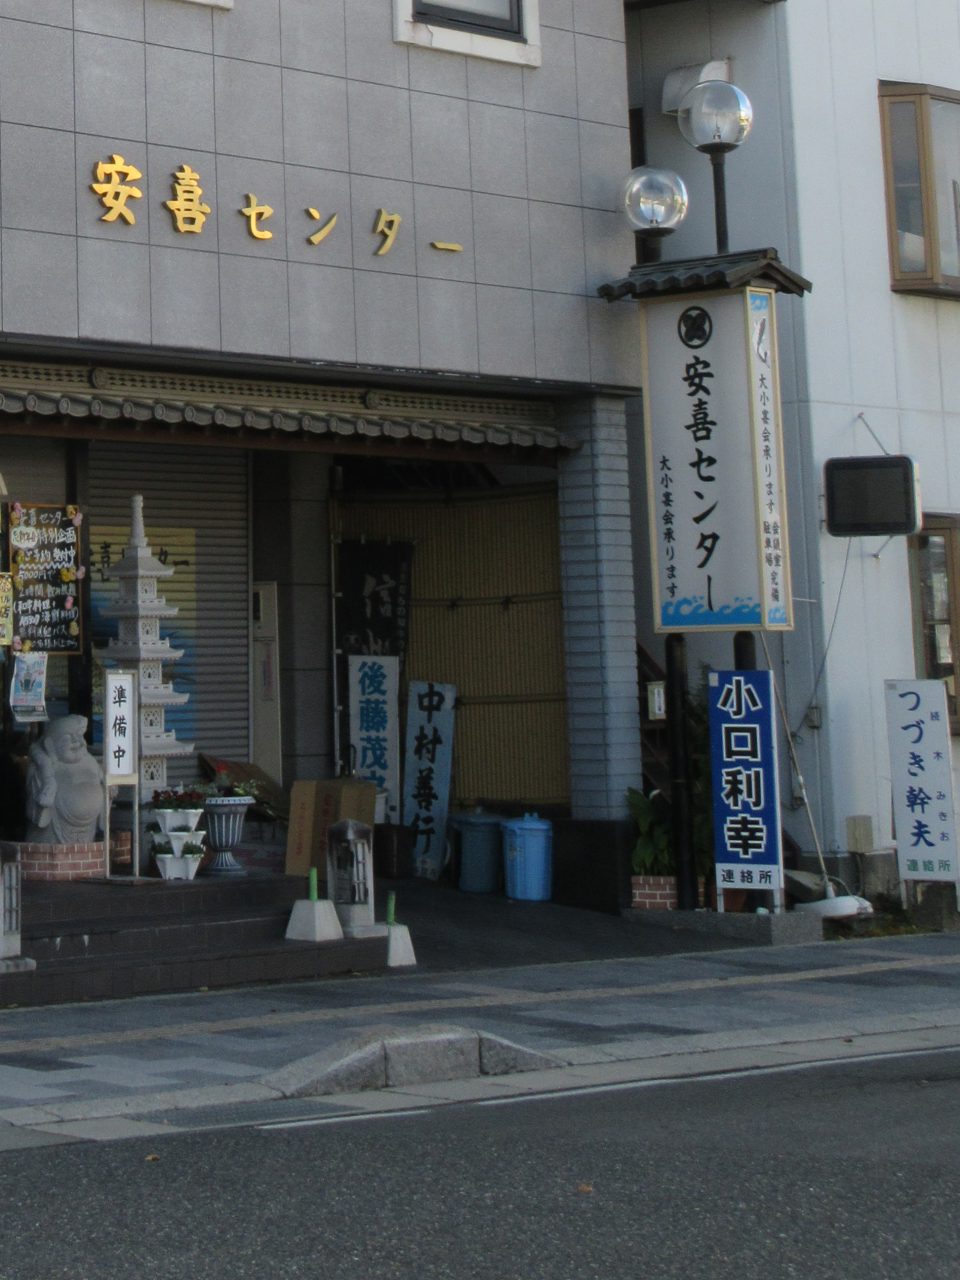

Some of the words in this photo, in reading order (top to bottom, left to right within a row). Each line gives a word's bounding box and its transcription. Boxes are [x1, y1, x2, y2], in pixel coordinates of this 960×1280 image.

[91, 154, 465, 256] 安喜センター
[681, 355, 721, 612] 安喜センター
[759, 373, 775, 514] 大小宴会承ります
[659, 454, 678, 599] 大小宴会承ります
[111, 684, 128, 770] 準備中
[411, 682, 446, 856] 中村善行
[716, 675, 768, 859] 小口利幸
[721, 869, 773, 884] 連絡所
[906, 859, 952, 873] 連絡所
